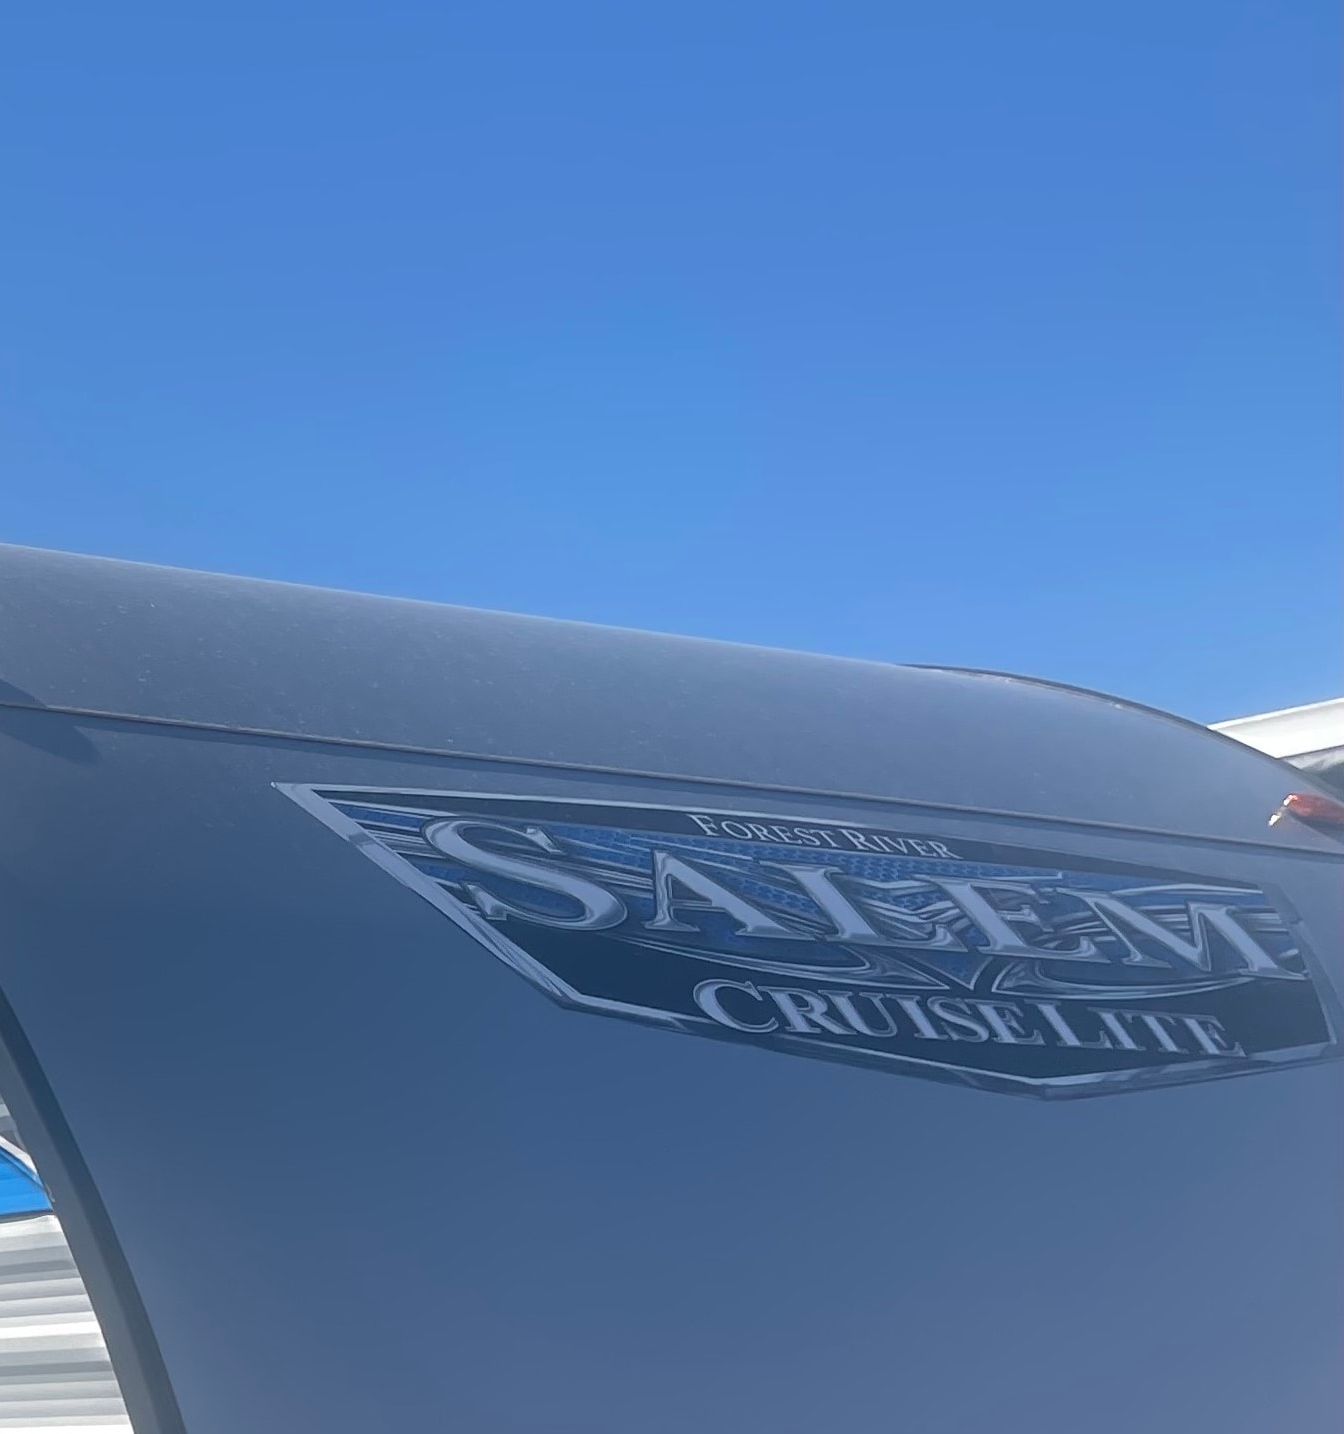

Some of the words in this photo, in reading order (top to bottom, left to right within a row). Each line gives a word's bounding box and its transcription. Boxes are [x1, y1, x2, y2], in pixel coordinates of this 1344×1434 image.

[686, 814, 842, 848] FOREST
[837, 829, 965, 861] RIVER
[423, 817, 1309, 982] SALEM
